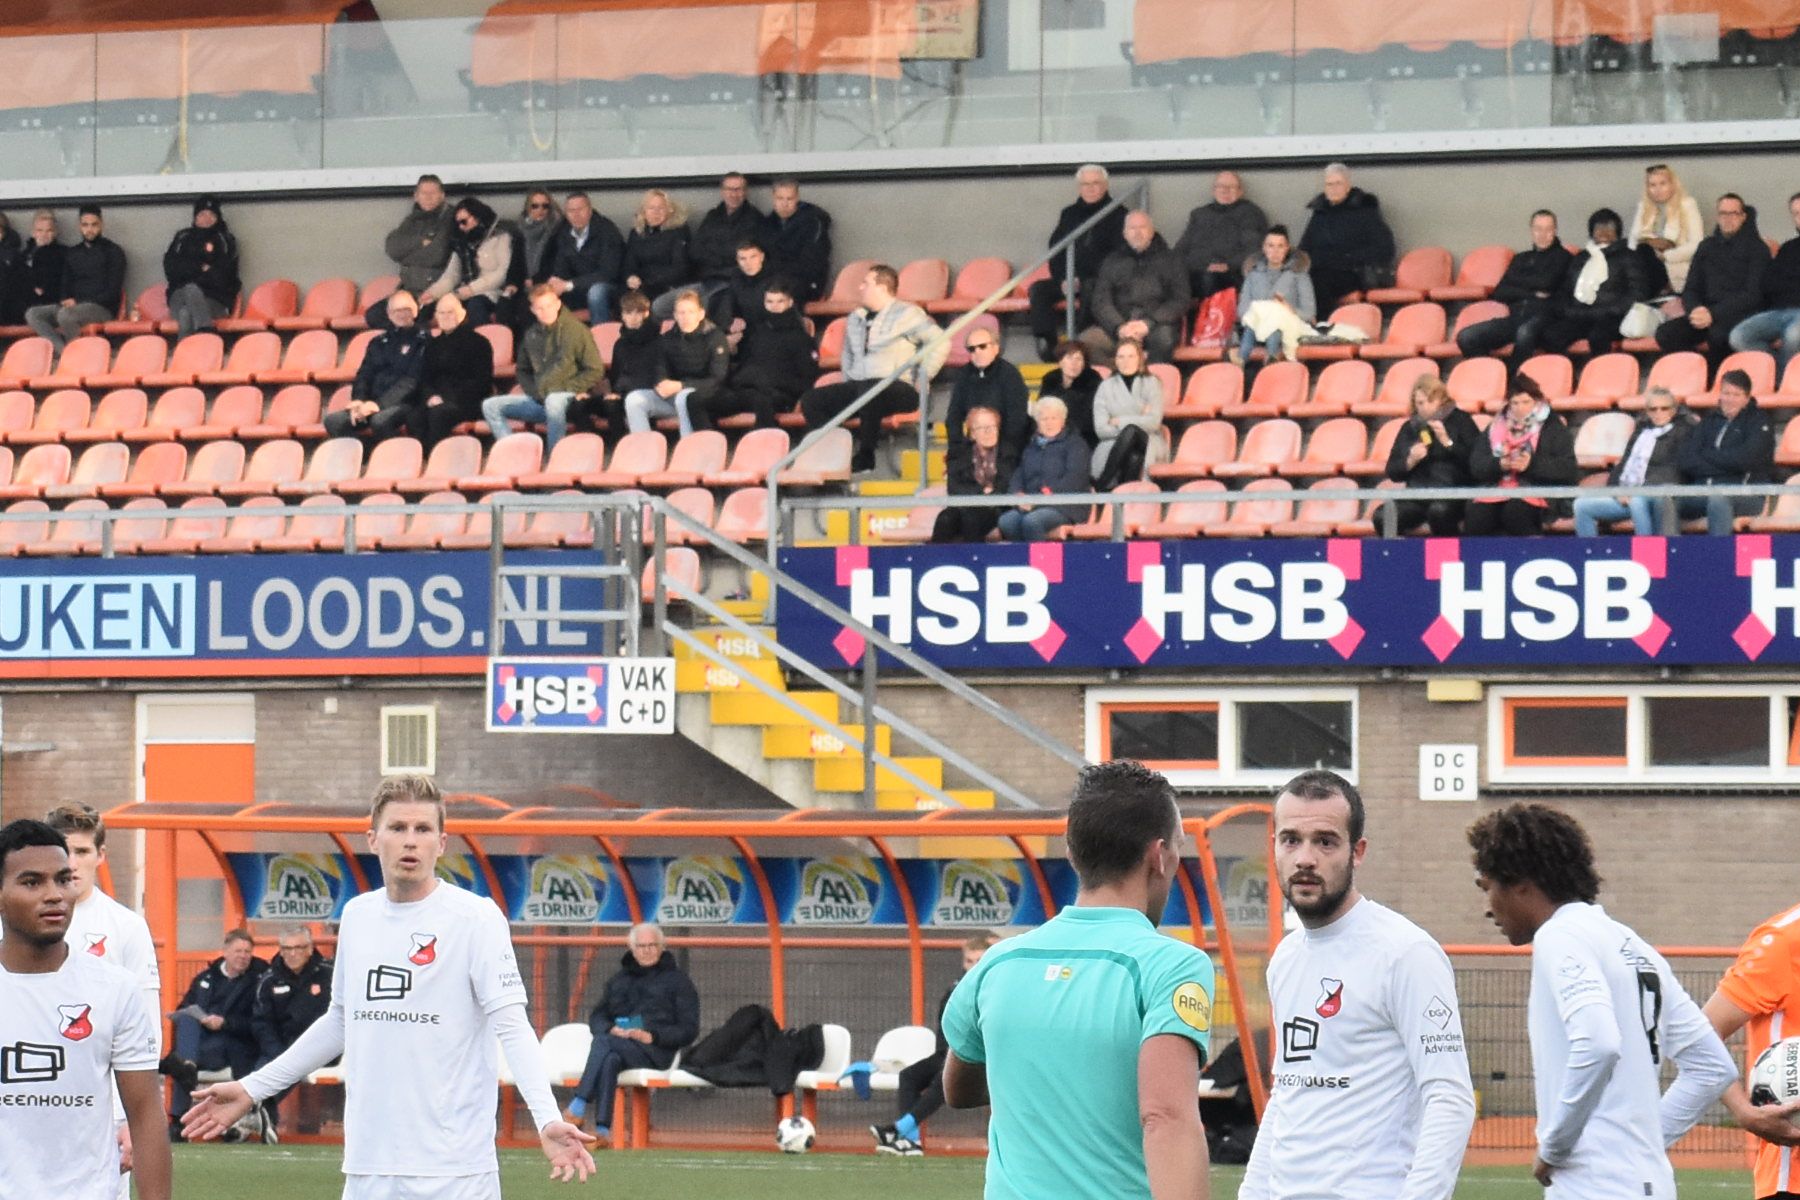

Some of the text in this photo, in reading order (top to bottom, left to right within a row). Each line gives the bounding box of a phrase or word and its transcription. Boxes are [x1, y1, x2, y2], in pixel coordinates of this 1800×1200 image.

[851, 566, 1051, 645] HSB
[1142, 562, 1349, 642] HSB
[1440, 559, 1653, 641] HSB
[620, 666, 667, 690] VAK
[504, 676, 598, 715] HSB
[619, 699, 667, 724] C+D
[285, 873, 316, 900] AA
[548, 876, 580, 902] AA
[682, 878, 715, 903] AA
[819, 878, 854, 904] AA
[959, 880, 994, 905] AA
[278, 900, 324, 916] DRINK
[542, 901, 587, 917] DRINK
[676, 902, 722, 918] DRINK
[813, 904, 861, 920] DRINK
[952, 905, 1001, 922] DRINK
